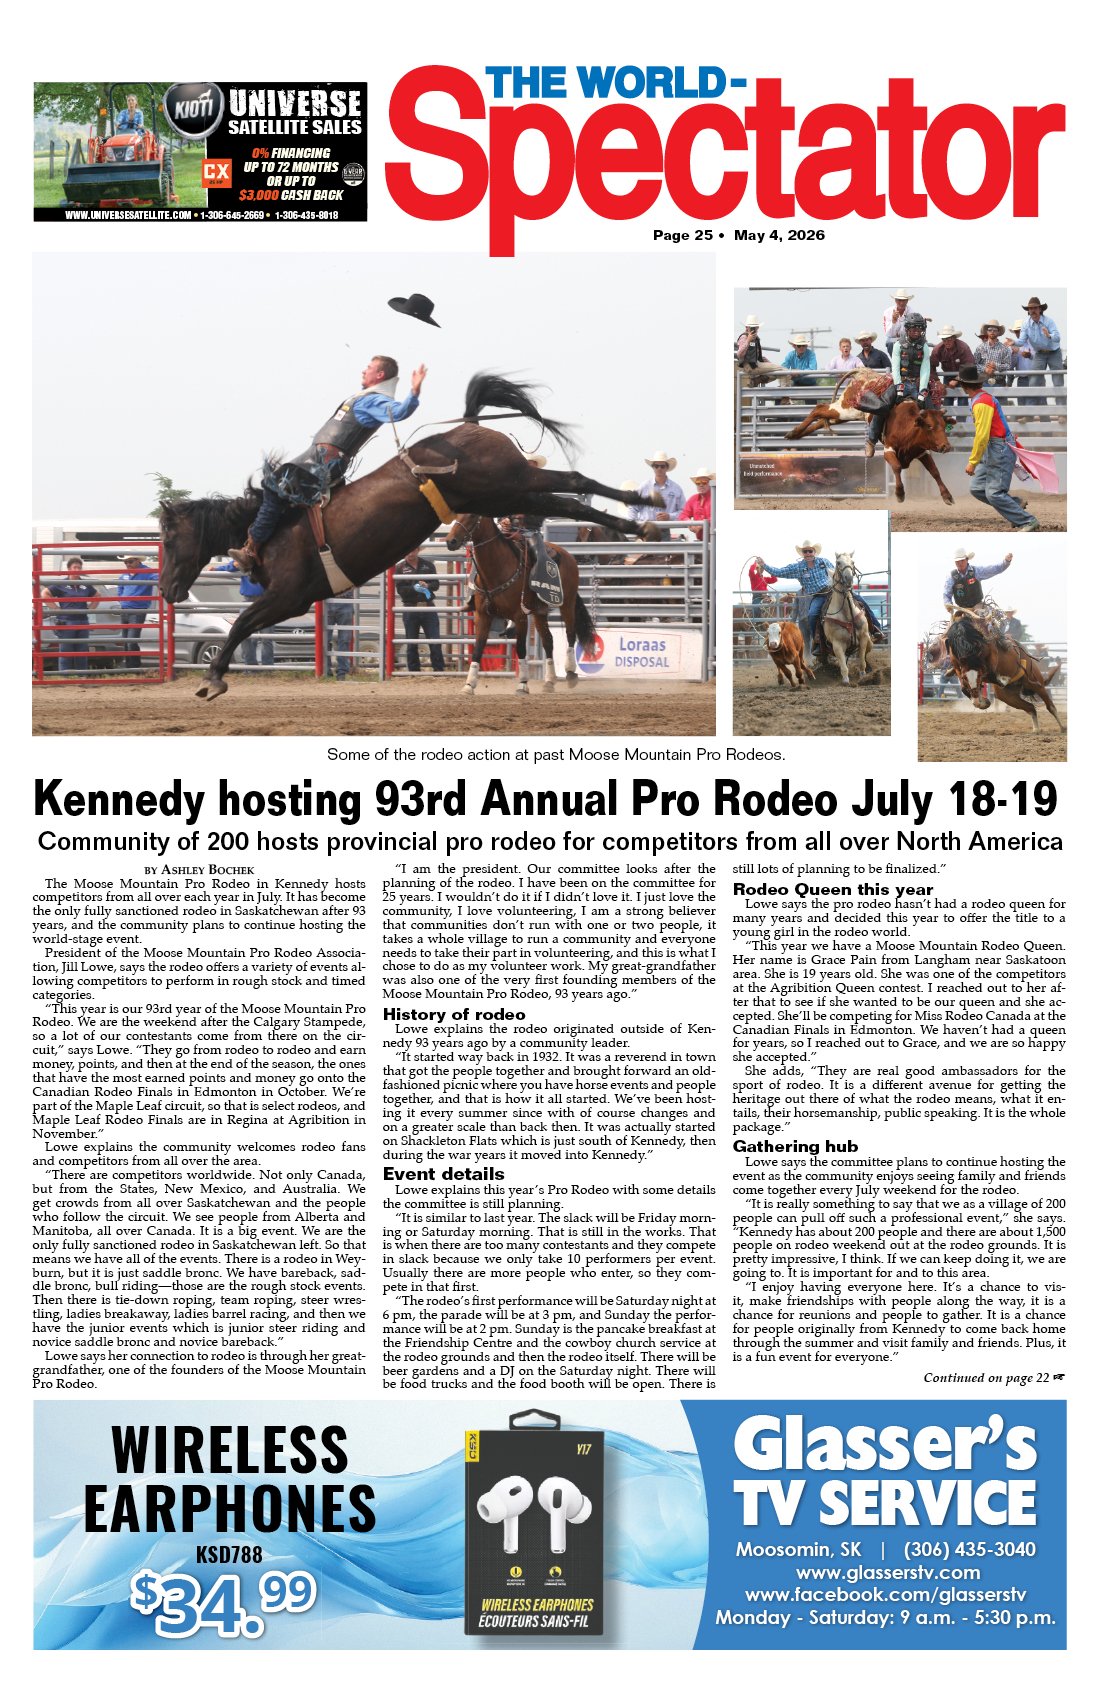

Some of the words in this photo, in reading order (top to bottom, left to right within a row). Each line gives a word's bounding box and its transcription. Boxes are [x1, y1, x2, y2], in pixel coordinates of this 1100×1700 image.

[485, 66, 567, 98] THE
[575, 66, 747, 98] WORLD-
[174, 99, 213, 120] KIOTI
[229, 89, 361, 117] UNIVERSE
[229, 120, 308, 134] SATELLITE
[313, 120, 362, 134] SALES
[252, 148, 269, 158] 0%
[271, 148, 330, 158] FINANCING
[244, 162, 259, 172] UP
[262, 162, 275, 172] TO
[277, 162, 290, 172] 72
[292, 162, 339, 172] MONTHS
[385, 65, 1066, 257] Spectator
[204, 164, 229, 179] CX
[267, 176, 282, 186] OR
[284, 176, 300, 186] UP
[302, 176, 316, 186] TO
[239, 190, 279, 201] $3,000
[281, 190, 311, 200] CASH
[313, 190, 344, 200] BACK
[65, 211, 191, 219] WWW.UNIVERSESATELLITE.COM
[201, 211, 264, 219] 1-306-645-2669
[275, 211, 338, 219] 1-306-435-8018
[654, 230, 689, 243] Page
[695, 230, 713, 240] 25
[735, 230, 765, 243] May
[769, 230, 782, 242] 4,
[788, 230, 825, 240] 2026
[530, 580, 560, 593] RAM
[620, 637, 666, 651] Loraas
[615, 656, 669, 668] DISPOSAL
[328, 748, 370, 760] Some
[375, 748, 389, 760] of
[394, 748, 415, 760] the
[422, 748, 462, 760] rodeo
[468, 750, 509, 760] action
[516, 749, 528, 760] at
[535, 750, 564, 764] past
[570, 748, 619, 760] Moose
[625, 748, 690, 760] Mountain
[697, 748, 720, 760] Pro
[727, 748, 785, 760] Rodeos.
[35, 779, 205, 825] Kennedy
[220, 779, 360, 825] hosting
[376, 779, 465, 816] 93rd
[481, 779, 616, 816] Annual
[633, 779, 699, 816] Pro
[715, 779, 837, 816] Rodeo
[852, 779, 933, 825] July
[950, 780, 1057, 816] 18-19
[38, 831, 170, 856] Community
[178, 831, 199, 850] of
[208, 832, 248, 850] 200
[258, 831, 318, 850] hosts
[328, 831, 436, 856] provincial
[447, 837, 482, 856] pro
[492, 831, 555, 850] rodeo
[563, 831, 595, 850] for
[603, 832, 737, 856] competitors
[746, 831, 796, 850] from
[806, 831, 830, 850] all
[840, 837, 889, 850] over
[898, 831, 960, 850] North
[968, 831, 1062, 850] America
[45, 878, 67, 888] The
[74, 879, 113, 888] Moose
[120, 879, 178, 888] Mountain
[185, 879, 205, 888] Pro
[212, 879, 250, 888] Rodeo
[257, 879, 269, 888] in
[275, 879, 328, 891] Kennedy
[335, 878, 366, 888] hosts
[735, 883, 788, 895] Rodeo
[795, 883, 851, 896] Queen
[858, 883, 889, 895] this
[896, 887, 933, 896] year
[32, 934, 103, 946] world-stage
[107, 935, 142, 943] event.
[384, 1008, 446, 1023] History
[452, 1008, 469, 1020] of
[476, 1008, 525, 1020] rodeo
[733, 1051, 752, 1061] she
[756, 1052, 816, 1065] accepted.”
[33, 1127, 104, 1138] November.”
[733, 1122, 790, 1135] package.”
[733, 1140, 819, 1155] Gathering
[826, 1140, 858, 1152] hub
[384, 1167, 435, 1180] Event
[442, 1167, 504, 1180] details
[395, 1185, 428, 1194] Lowe
[431, 1185, 480, 1198] explains
[484, 1184, 505, 1194] this
[508, 1185, 544, 1198] year’s
[548, 1185, 568, 1194] Pro
[571, 1185, 609, 1194] Rodeo
[612, 1184, 639, 1194] with
[677, 1185, 716, 1194] details
[733, 1352, 742, 1361] is
[756, 1351, 776, 1361] fun
[779, 1353, 811, 1361] event
[815, 1351, 832, 1361] for
[835, 1352, 898, 1365] everyone.”
[33, 1379, 53, 1388] Pro
[56, 1379, 97, 1388] Rodeo.
[924, 1373, 984, 1382] Continued
[1006, 1376, 1033, 1386] page
[1036, 1373, 1049, 1382] 22
[469, 1434, 477, 1459] KSD
[735, 1414, 1036, 1470] Glasser’s
[112, 1426, 347, 1473] WIRELESS
[577, 1444, 592, 1455] Y17
[86, 1485, 375, 1532] EARPHONES
[734, 1480, 805, 1525] TV
[820, 1480, 1036, 1525] SERVICE
[197, 1546, 262, 1563] KSD788
[736, 1542, 834, 1558] Moosomin,
[841, 1542, 861, 1556] SK
[905, 1542, 949, 1560] (306)
[955, 1542, 1035, 1556] 435-3040
[796, 1565, 980, 1583] www.glasserstv.com
[745, 1587, 1026, 1605] www.facebook.com/glasserstv
[482, 1599, 531, 1611] WIRELESS
[533, 1599, 594, 1611] EARPHONES
[479, 1612, 539, 1627] ÉCOUTEURS
[541, 1615, 588, 1627] SANS-FIL
[716, 1610, 791, 1628] Monday
[810, 1610, 893, 1628] Saturday:
[901, 1610, 910, 1624] 9
[916, 1614, 954, 1624] a.m.
[975, 1610, 1010, 1624] 5:30
[1017, 1614, 1055, 1628] p.m.
